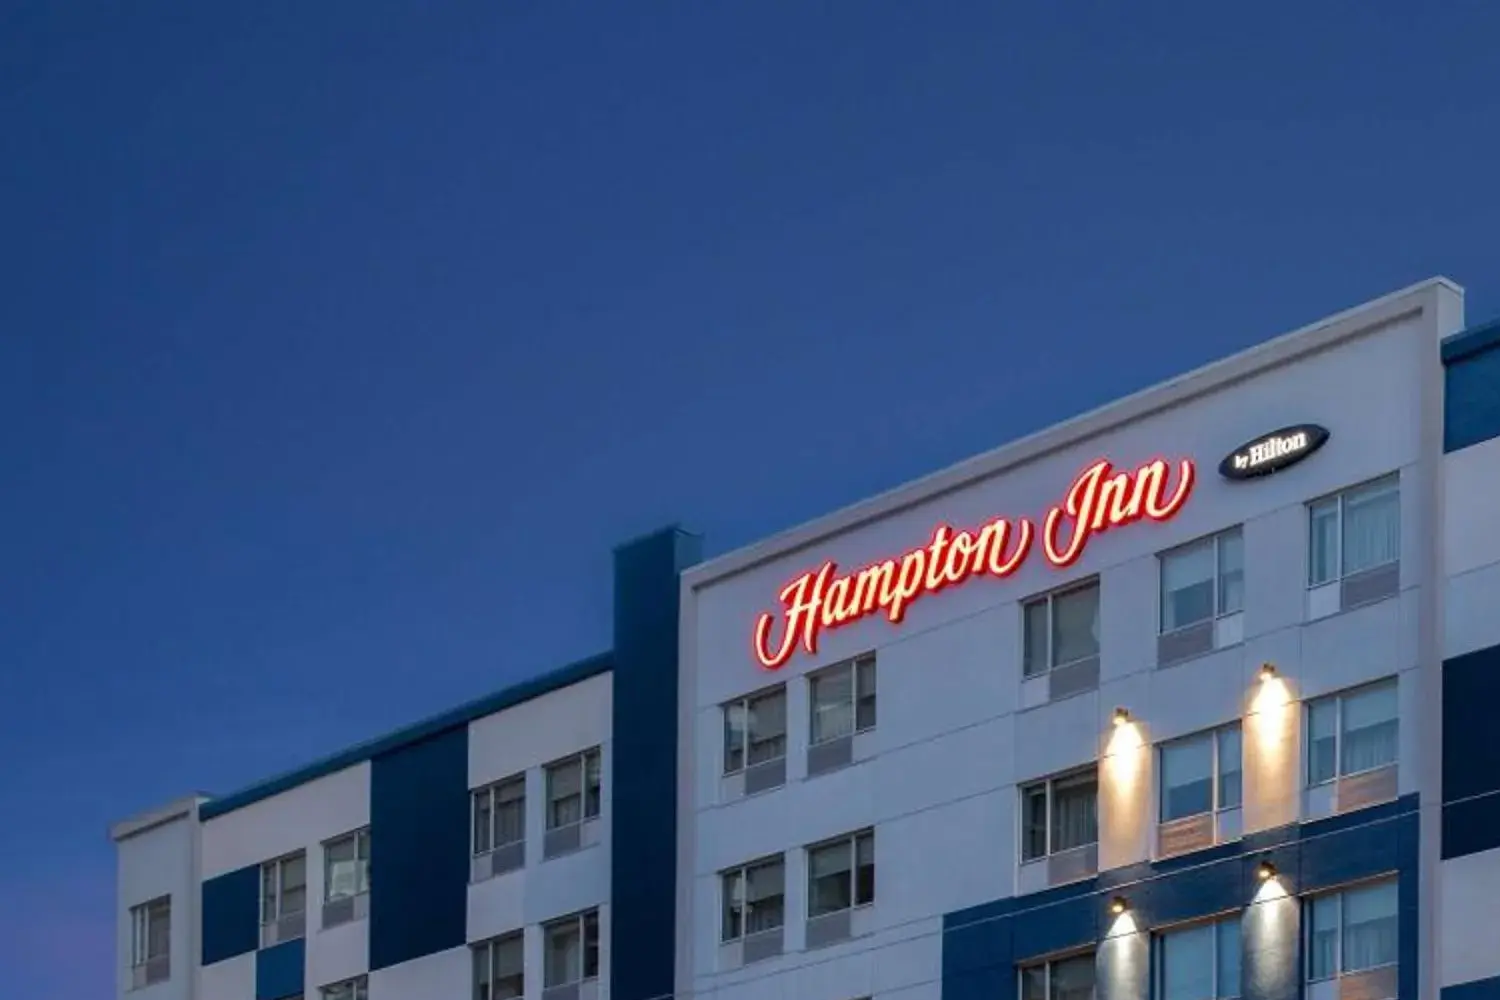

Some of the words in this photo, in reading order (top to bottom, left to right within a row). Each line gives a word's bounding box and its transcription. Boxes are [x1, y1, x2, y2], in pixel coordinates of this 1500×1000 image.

[1234, 454, 1249, 469] by
[1249, 431, 1308, 467] Hilton
[754, 517, 1034, 670] Hampton
[1043, 458, 1195, 567] Inn
